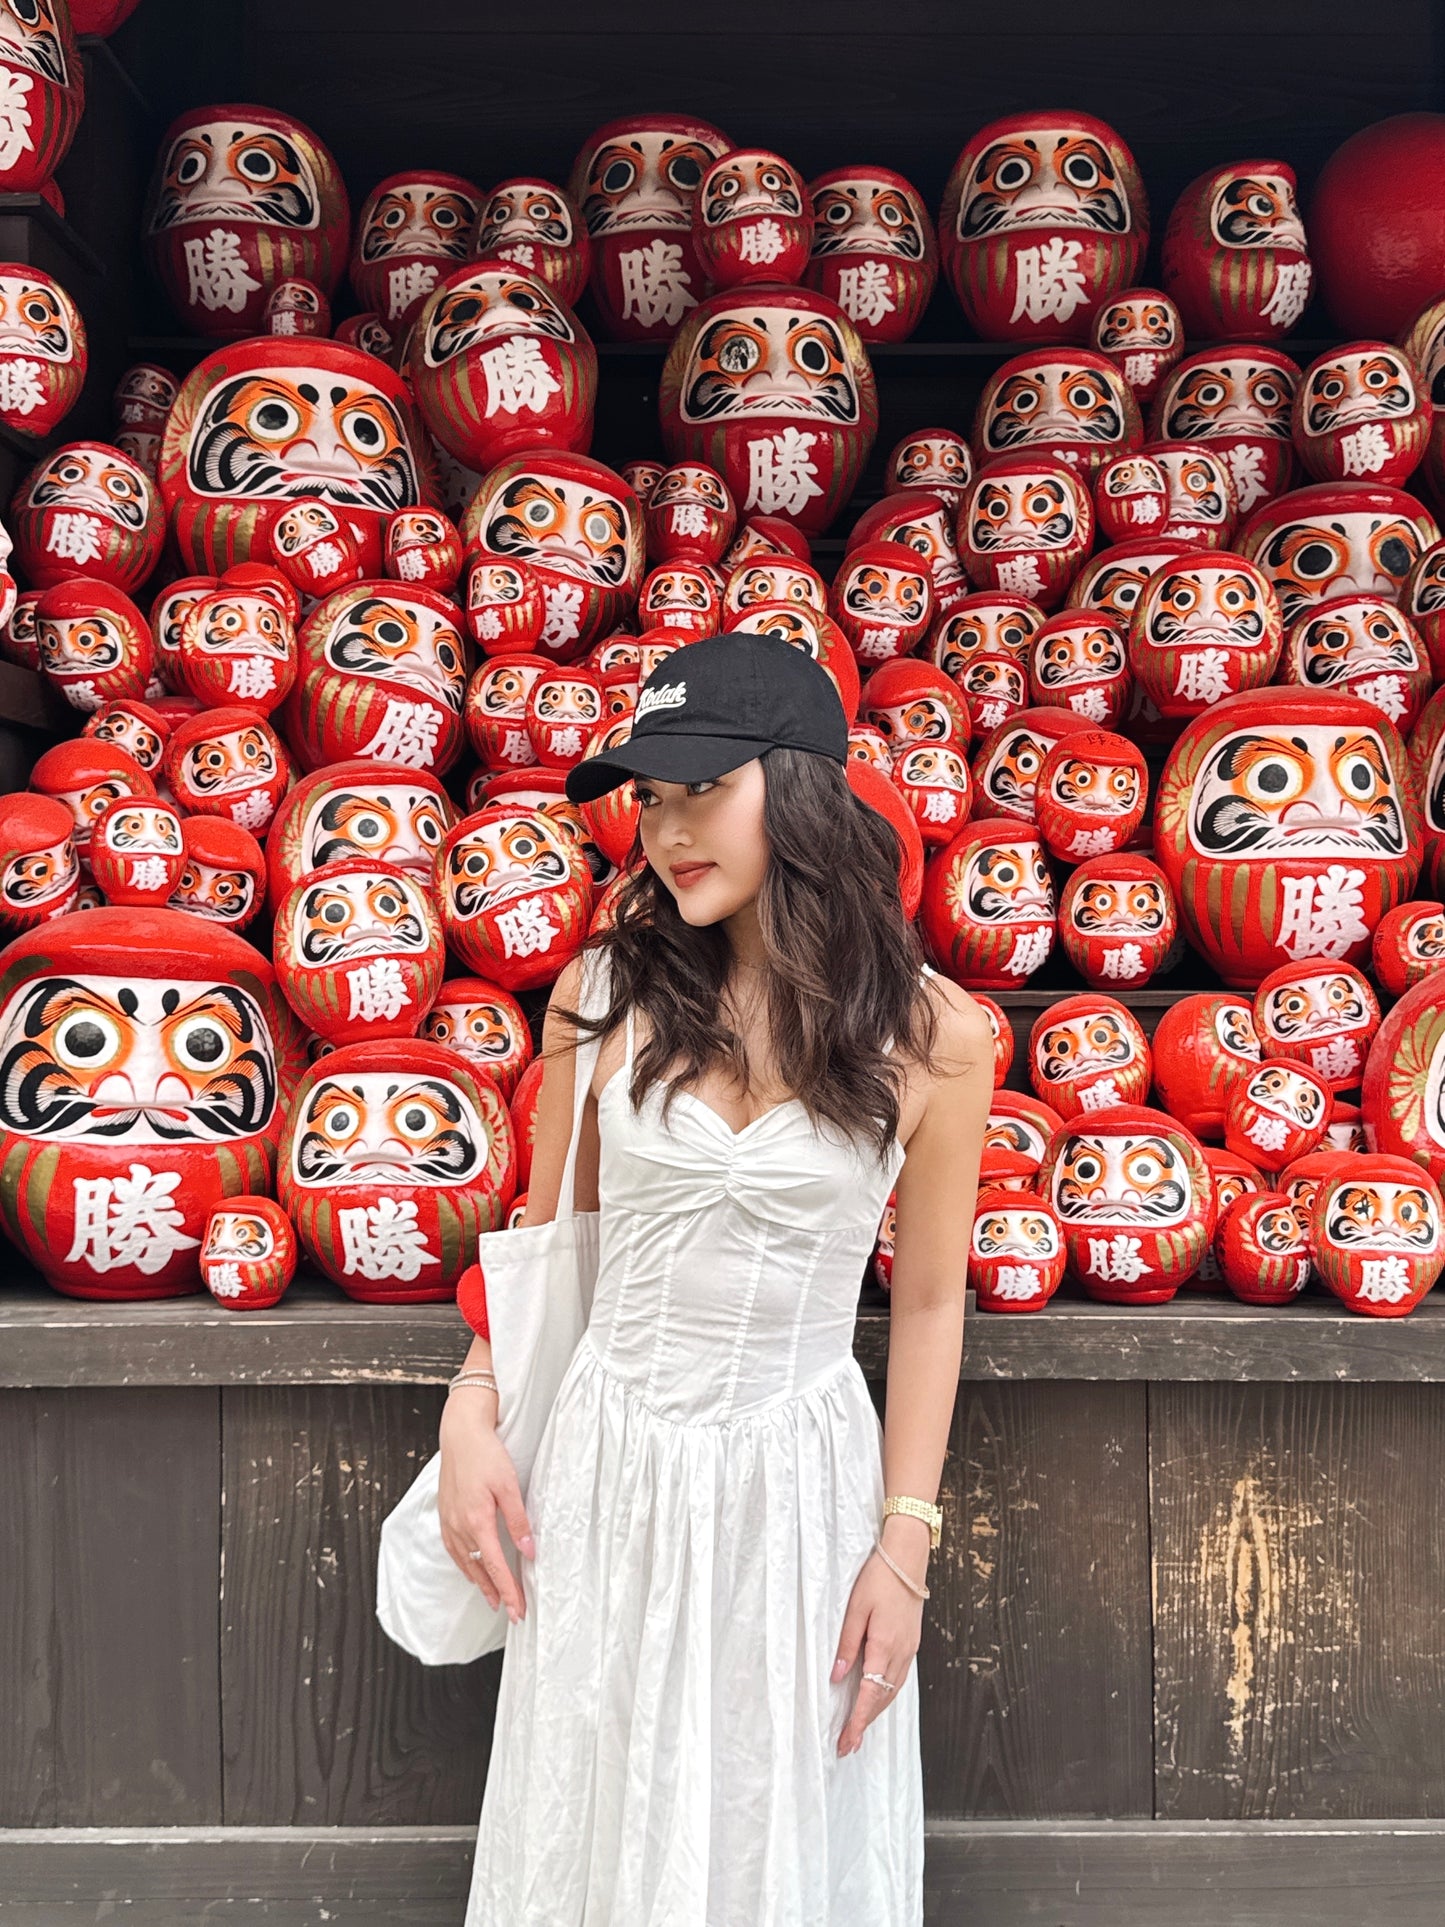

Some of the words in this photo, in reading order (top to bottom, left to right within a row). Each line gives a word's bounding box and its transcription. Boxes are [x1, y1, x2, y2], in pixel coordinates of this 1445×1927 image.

[739, 218, 785, 264] 勝
[184, 228, 262, 312] 勝
[619, 239, 698, 327] 勝
[1009, 237, 1092, 324] 勝
[838, 260, 895, 326] 勝
[1258, 261, 1312, 328] 勝
[271, 311, 297, 336] 勝
[0, 358, 47, 415] 勝
[480, 337, 561, 418] 勝
[1125, 353, 1157, 386] 勝
[745, 427, 823, 515] 勝
[1341, 424, 1394, 474] 勝
[670, 504, 710, 537] 勝
[1132, 494, 1161, 523] 勝
[46, 513, 103, 564] 勝
[304, 541, 343, 579] 勝
[396, 548, 432, 580] 勝
[996, 555, 1047, 599] 勝
[475, 606, 504, 640] 勝
[858, 629, 900, 657] 勝
[227, 656, 278, 700] 勝
[1174, 649, 1232, 704] 勝
[1355, 675, 1408, 722] 勝
[634, 681, 687, 722] Kodak
[978, 700, 1008, 728] 勝
[1071, 689, 1112, 724] 勝
[355, 701, 445, 770] 勝
[549, 726, 585, 756] 勝
[230, 789, 274, 830] 勝
[922, 792, 957, 823] 勝
[1065, 827, 1117, 857] 勝
[130, 857, 170, 891] 勝
[495, 897, 560, 959] 勝
[1276, 865, 1370, 961] 勝
[1001, 926, 1053, 976] 勝
[1101, 944, 1146, 979] 勝
[347, 958, 413, 1021] 勝
[1310, 1037, 1360, 1080] 勝
[1245, 1114, 1291, 1151] 勝
[65, 1164, 202, 1276] 勝
[342, 1198, 440, 1281] 勝
[208, 1263, 248, 1297] 勝
[1089, 1235, 1154, 1283] 勝
[1355, 1257, 1413, 1302] 勝
[992, 1265, 1041, 1300] 勝
